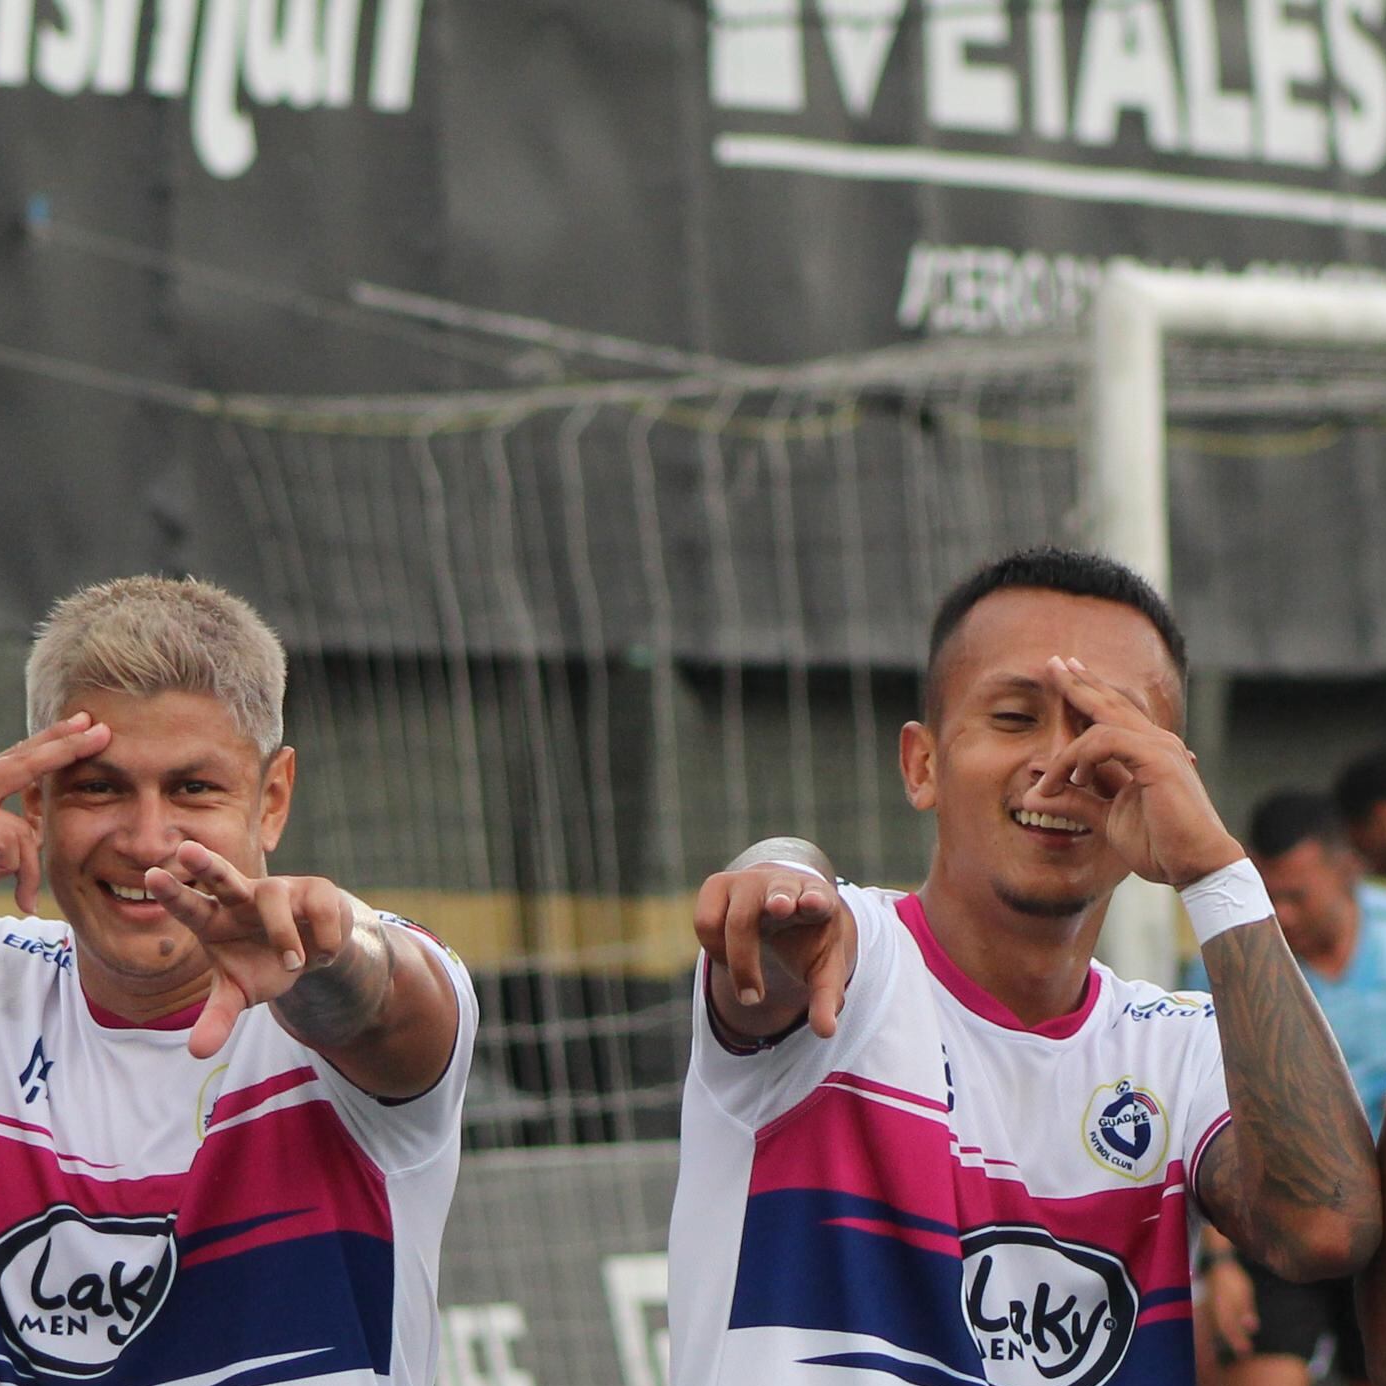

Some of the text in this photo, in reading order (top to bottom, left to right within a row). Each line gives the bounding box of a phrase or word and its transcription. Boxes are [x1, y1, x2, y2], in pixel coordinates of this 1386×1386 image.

[1089, 1130, 1133, 1171] FUTBOL CLUB
[18, 1313, 88, 1336] MEN
